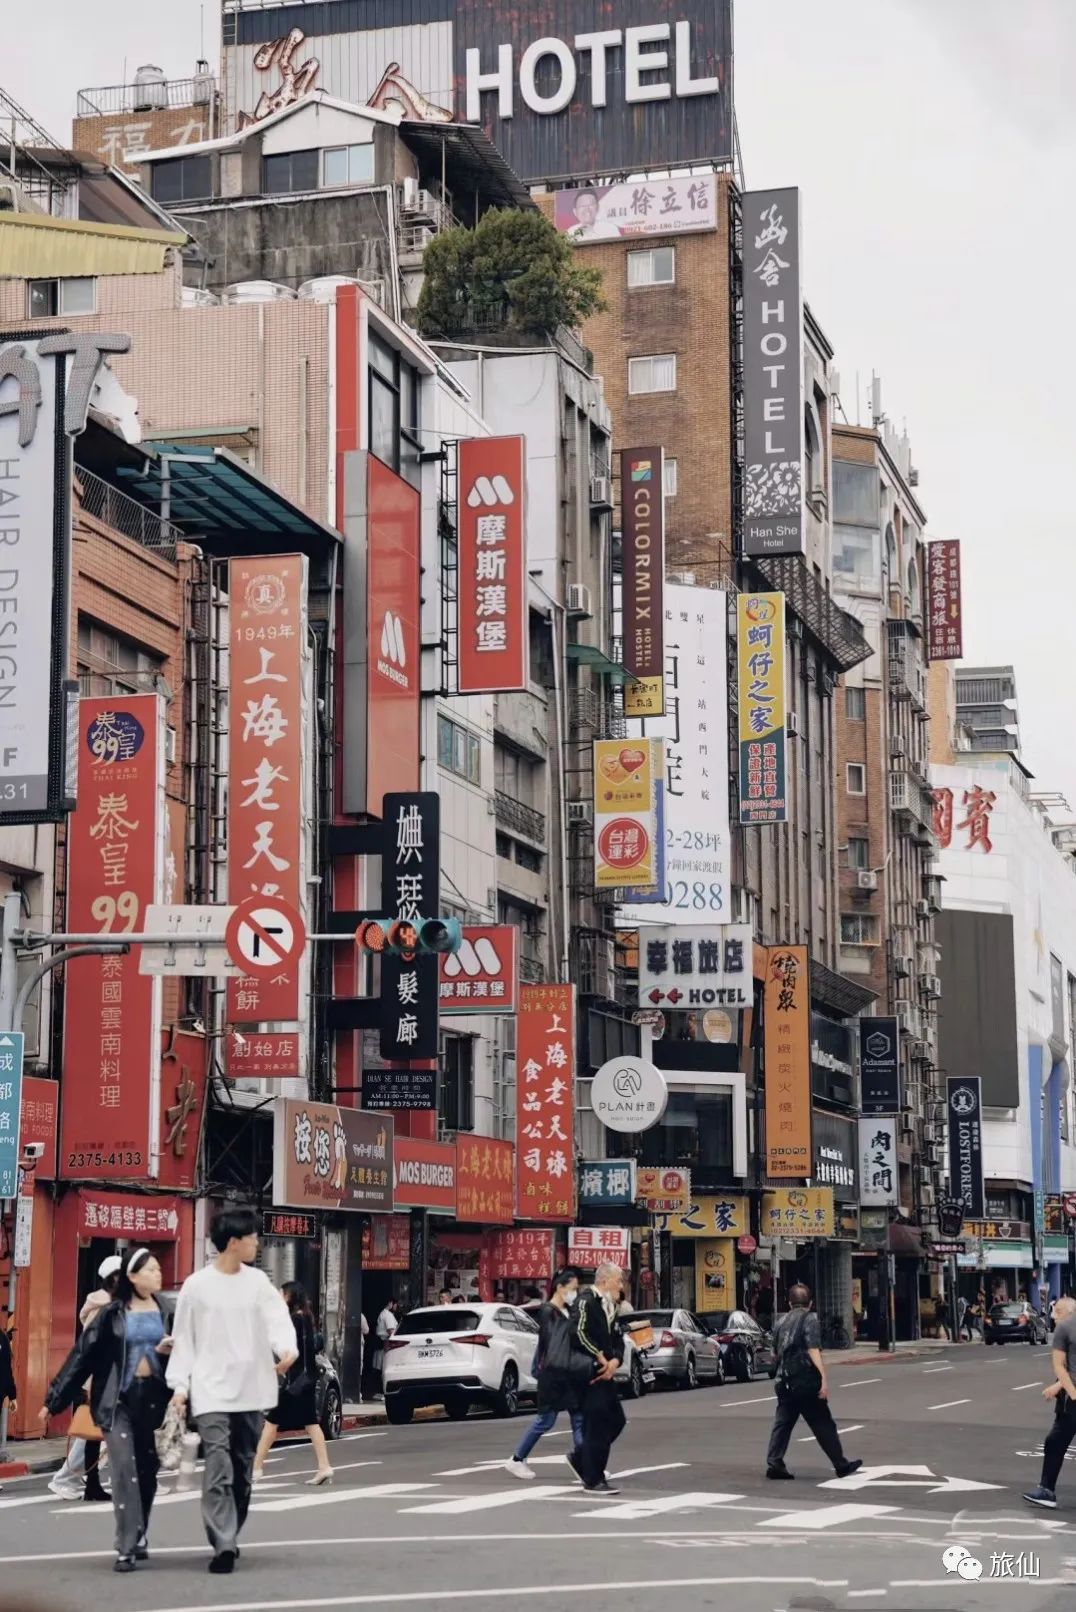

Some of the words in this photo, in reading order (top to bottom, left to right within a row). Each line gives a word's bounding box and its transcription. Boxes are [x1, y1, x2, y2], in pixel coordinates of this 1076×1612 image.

[466, 21, 719, 123] HOTEL
[631, 182, 709, 215] 徐立信
[760, 300, 787, 454] HOTEL
[750, 528, 772, 537] Han
[776, 525, 798, 536] She
[764, 538, 784, 547] Hotel
[634, 487, 651, 620] COLORMIX
[476, 514, 506, 652] 摩斯漢堡
[235, 624, 295, 641] 1949年
[748, 623, 775, 733] 蚵仔之家
[440, 981, 504, 997] 摩斯漢堡
[689, 988, 746, 1003] HOTEL
[99, 955, 122, 1108] 泰國雲南料理
[232, 1040, 293, 1057] 創始店
[545, 1013, 568, 1179] 上海老天祿
[599, 1102, 633, 1112] PLAN
[522, 1058, 543, 1173] 食品公司
[68, 1152, 142, 1168] 2375-4133
[399, 1161, 420, 1184] MOS
[420, 1162, 453, 1187] BURGER
[871, 1130, 893, 1194] 肉之間
[580, 1169, 630, 1198] 檳榔
[573, 1230, 622, 1247] 自租
